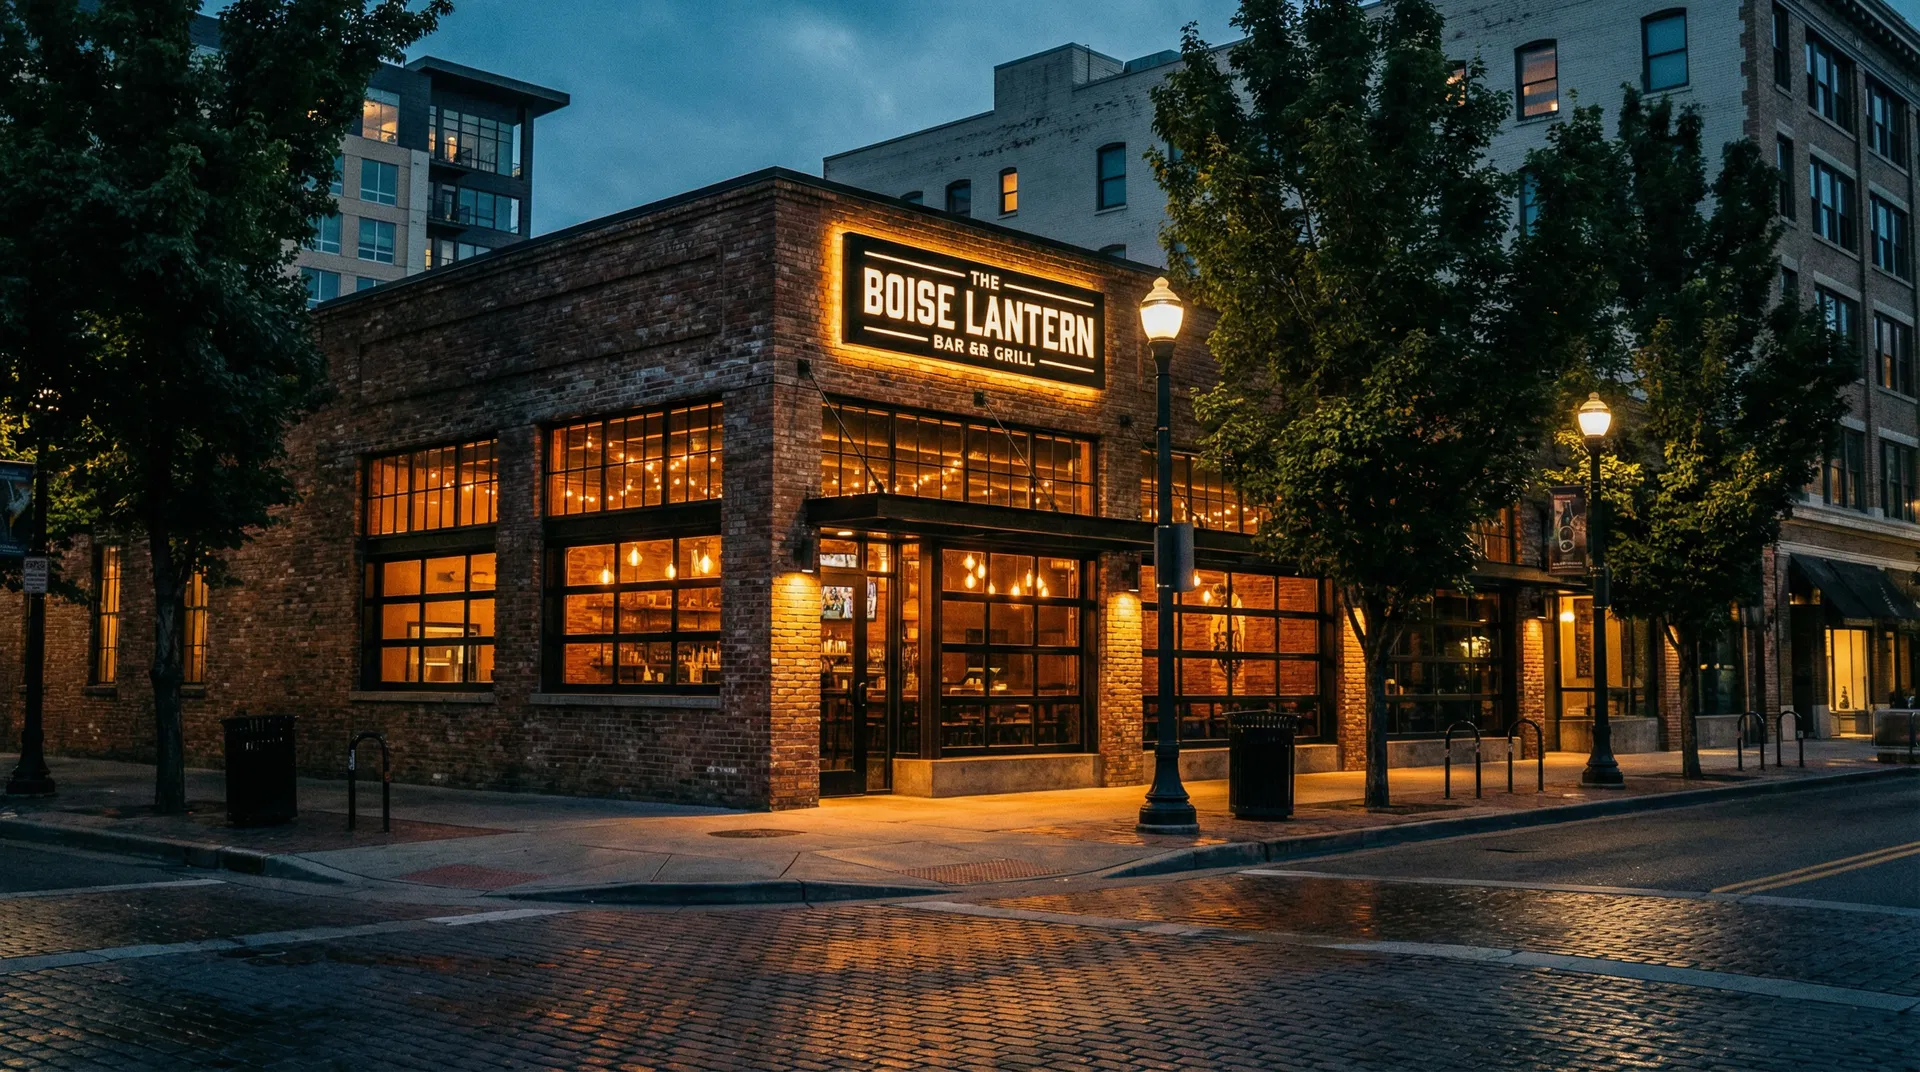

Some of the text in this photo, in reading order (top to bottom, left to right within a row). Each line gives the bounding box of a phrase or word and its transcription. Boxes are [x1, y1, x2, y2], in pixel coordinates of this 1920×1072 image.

[970, 270, 1000, 290] THE
[863, 266, 1095, 359] BOISE LANTERN
[933, 334, 965, 354] BAR
[994, 346, 1036, 366] GRILL
